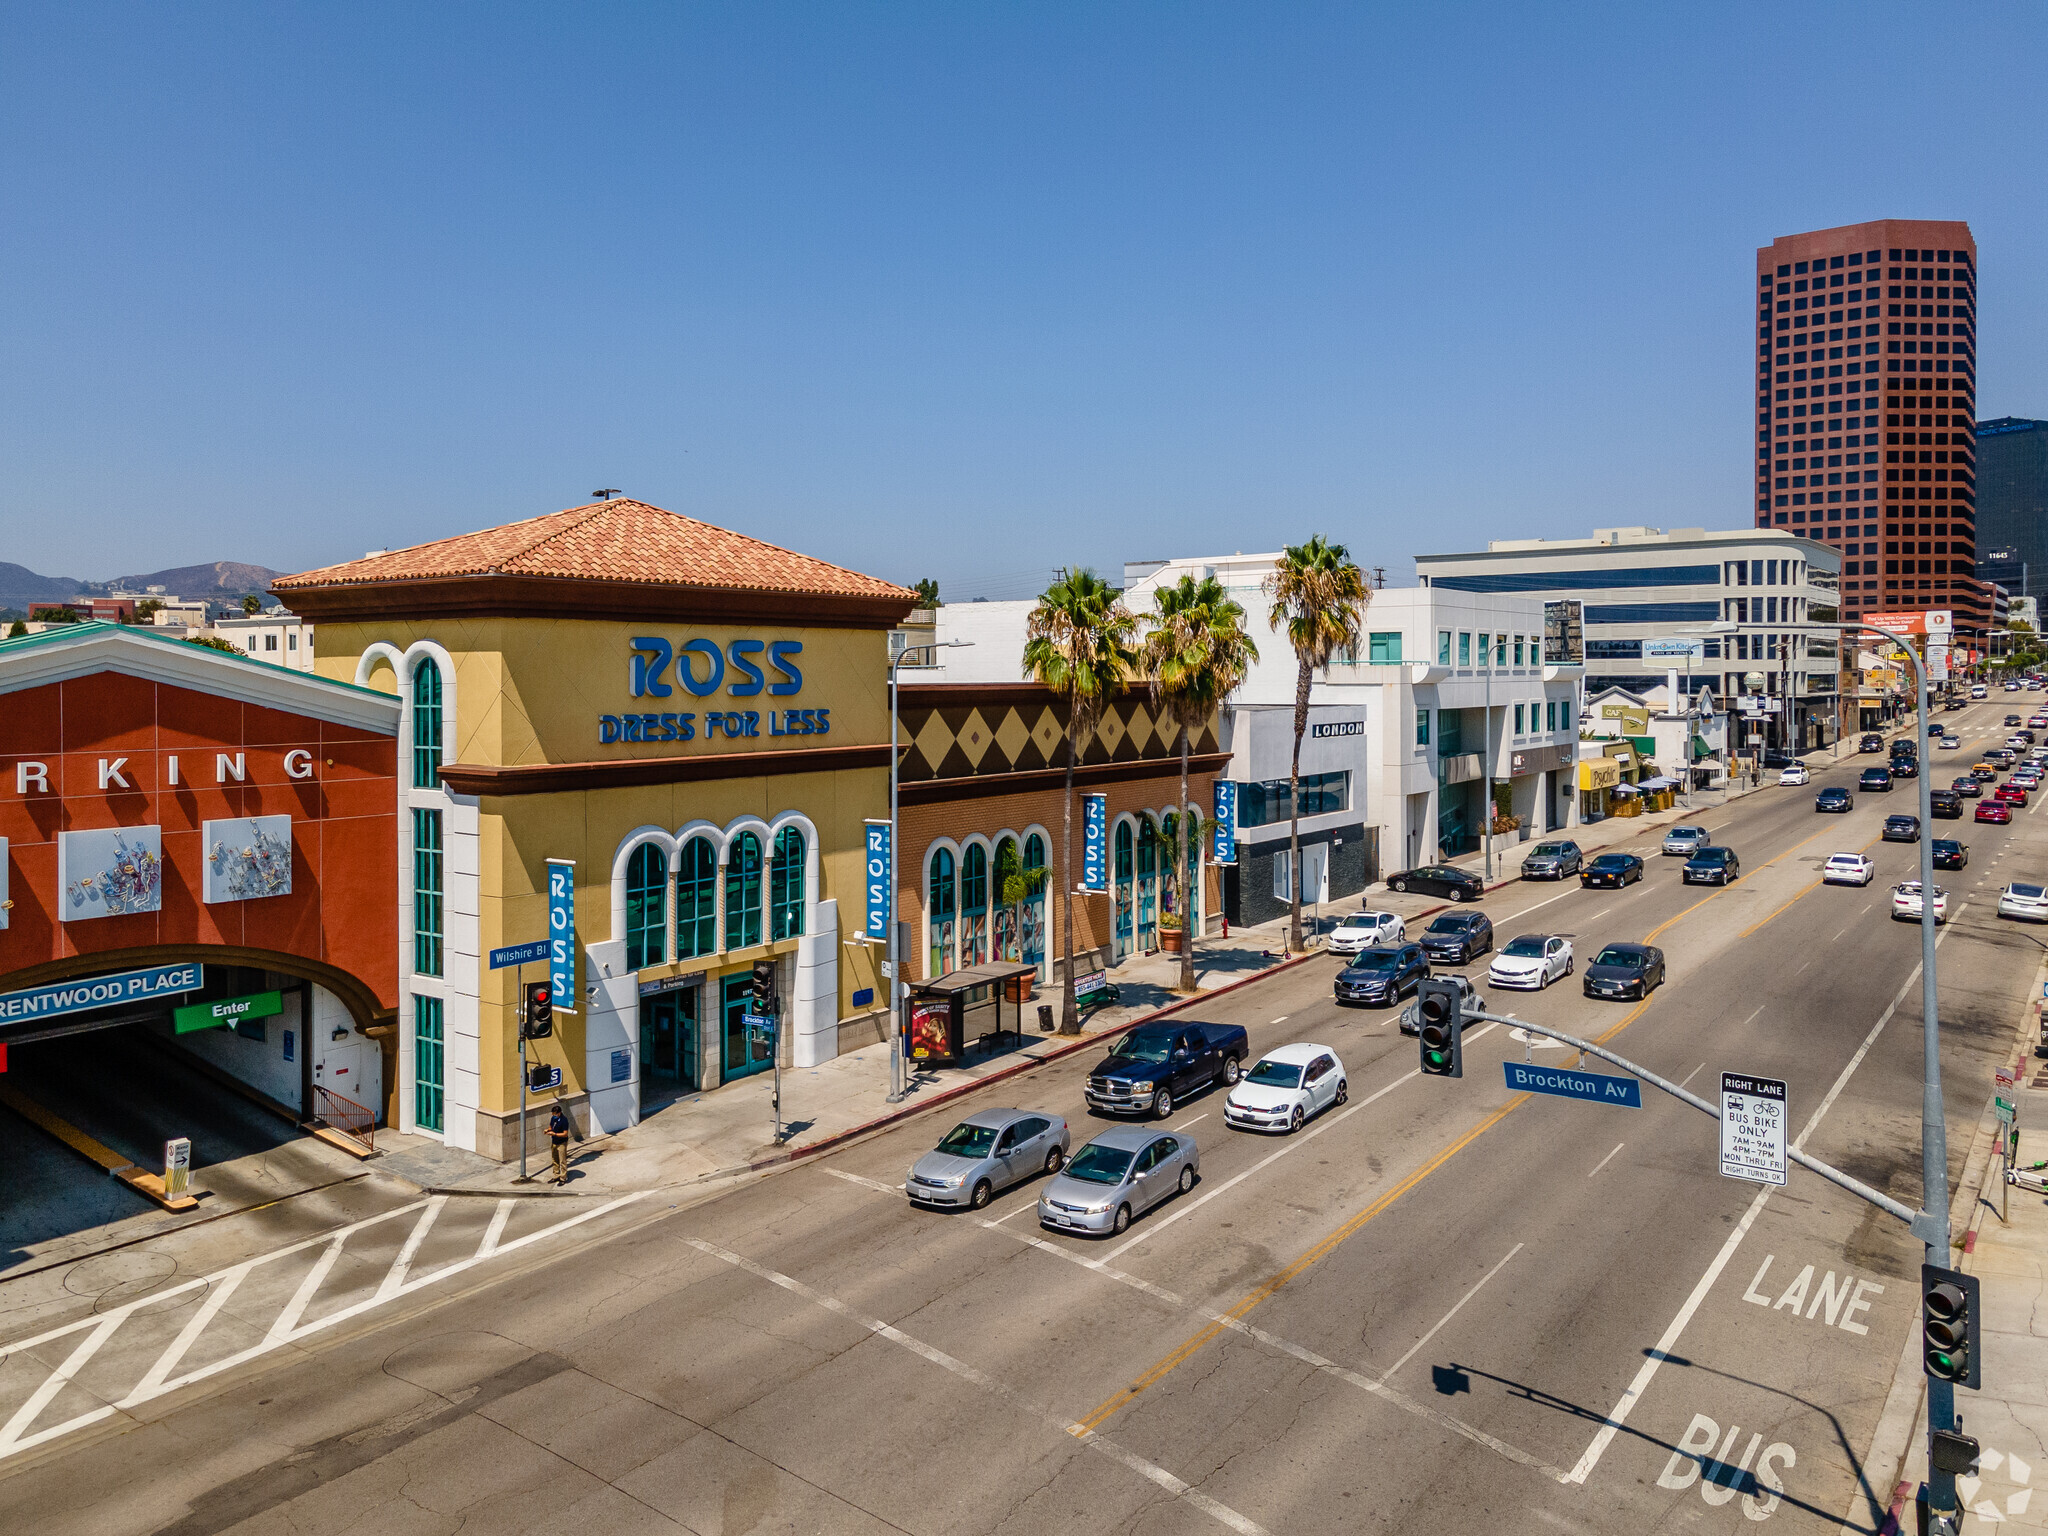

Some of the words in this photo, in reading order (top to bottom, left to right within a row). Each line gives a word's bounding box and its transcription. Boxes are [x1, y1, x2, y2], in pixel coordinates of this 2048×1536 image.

[629, 637, 803, 698] ROSS
[598, 713, 696, 744] DRESS
[705, 711, 760, 739] FOR
[768, 709, 830, 736] LESS
[1315, 722, 1363, 737] LONDON
[1593, 766, 1616, 787] Psychic
[1216, 786, 1228, 857] ROSS
[1086, 802, 1098, 883] ROSS
[868, 832, 884, 931] ROSS
[551, 873, 567, 997] ROSS
[495, 947, 533, 963] Wilshire
[128, 969, 195, 995] PLACE
[212, 1001, 251, 1017] Enter
[1515, 1069, 1596, 1094] Brockton
[1605, 1082, 1628, 1098] Av
[1725, 1078, 1753, 1091] RIGHT
[1757, 1083, 1782, 1096] LANE
[1729, 1112, 1749, 1124] BUS
[1754, 1116, 1777, 1129] BIKE
[1739, 1125, 1767, 1138] ONLY
[1724, 1153, 1741, 1162] MON
[1745, 1156, 1766, 1166] THRU
[1770, 1161, 1783, 1169] FRI
[1725, 1165, 1744, 1175] RIGHT
[1747, 1168, 1769, 1179] TURNS
[1772, 1173, 1781, 1181] OK
[1742, 1254, 1885, 1336] LANE
[1656, 1413, 1797, 1521] BUS
